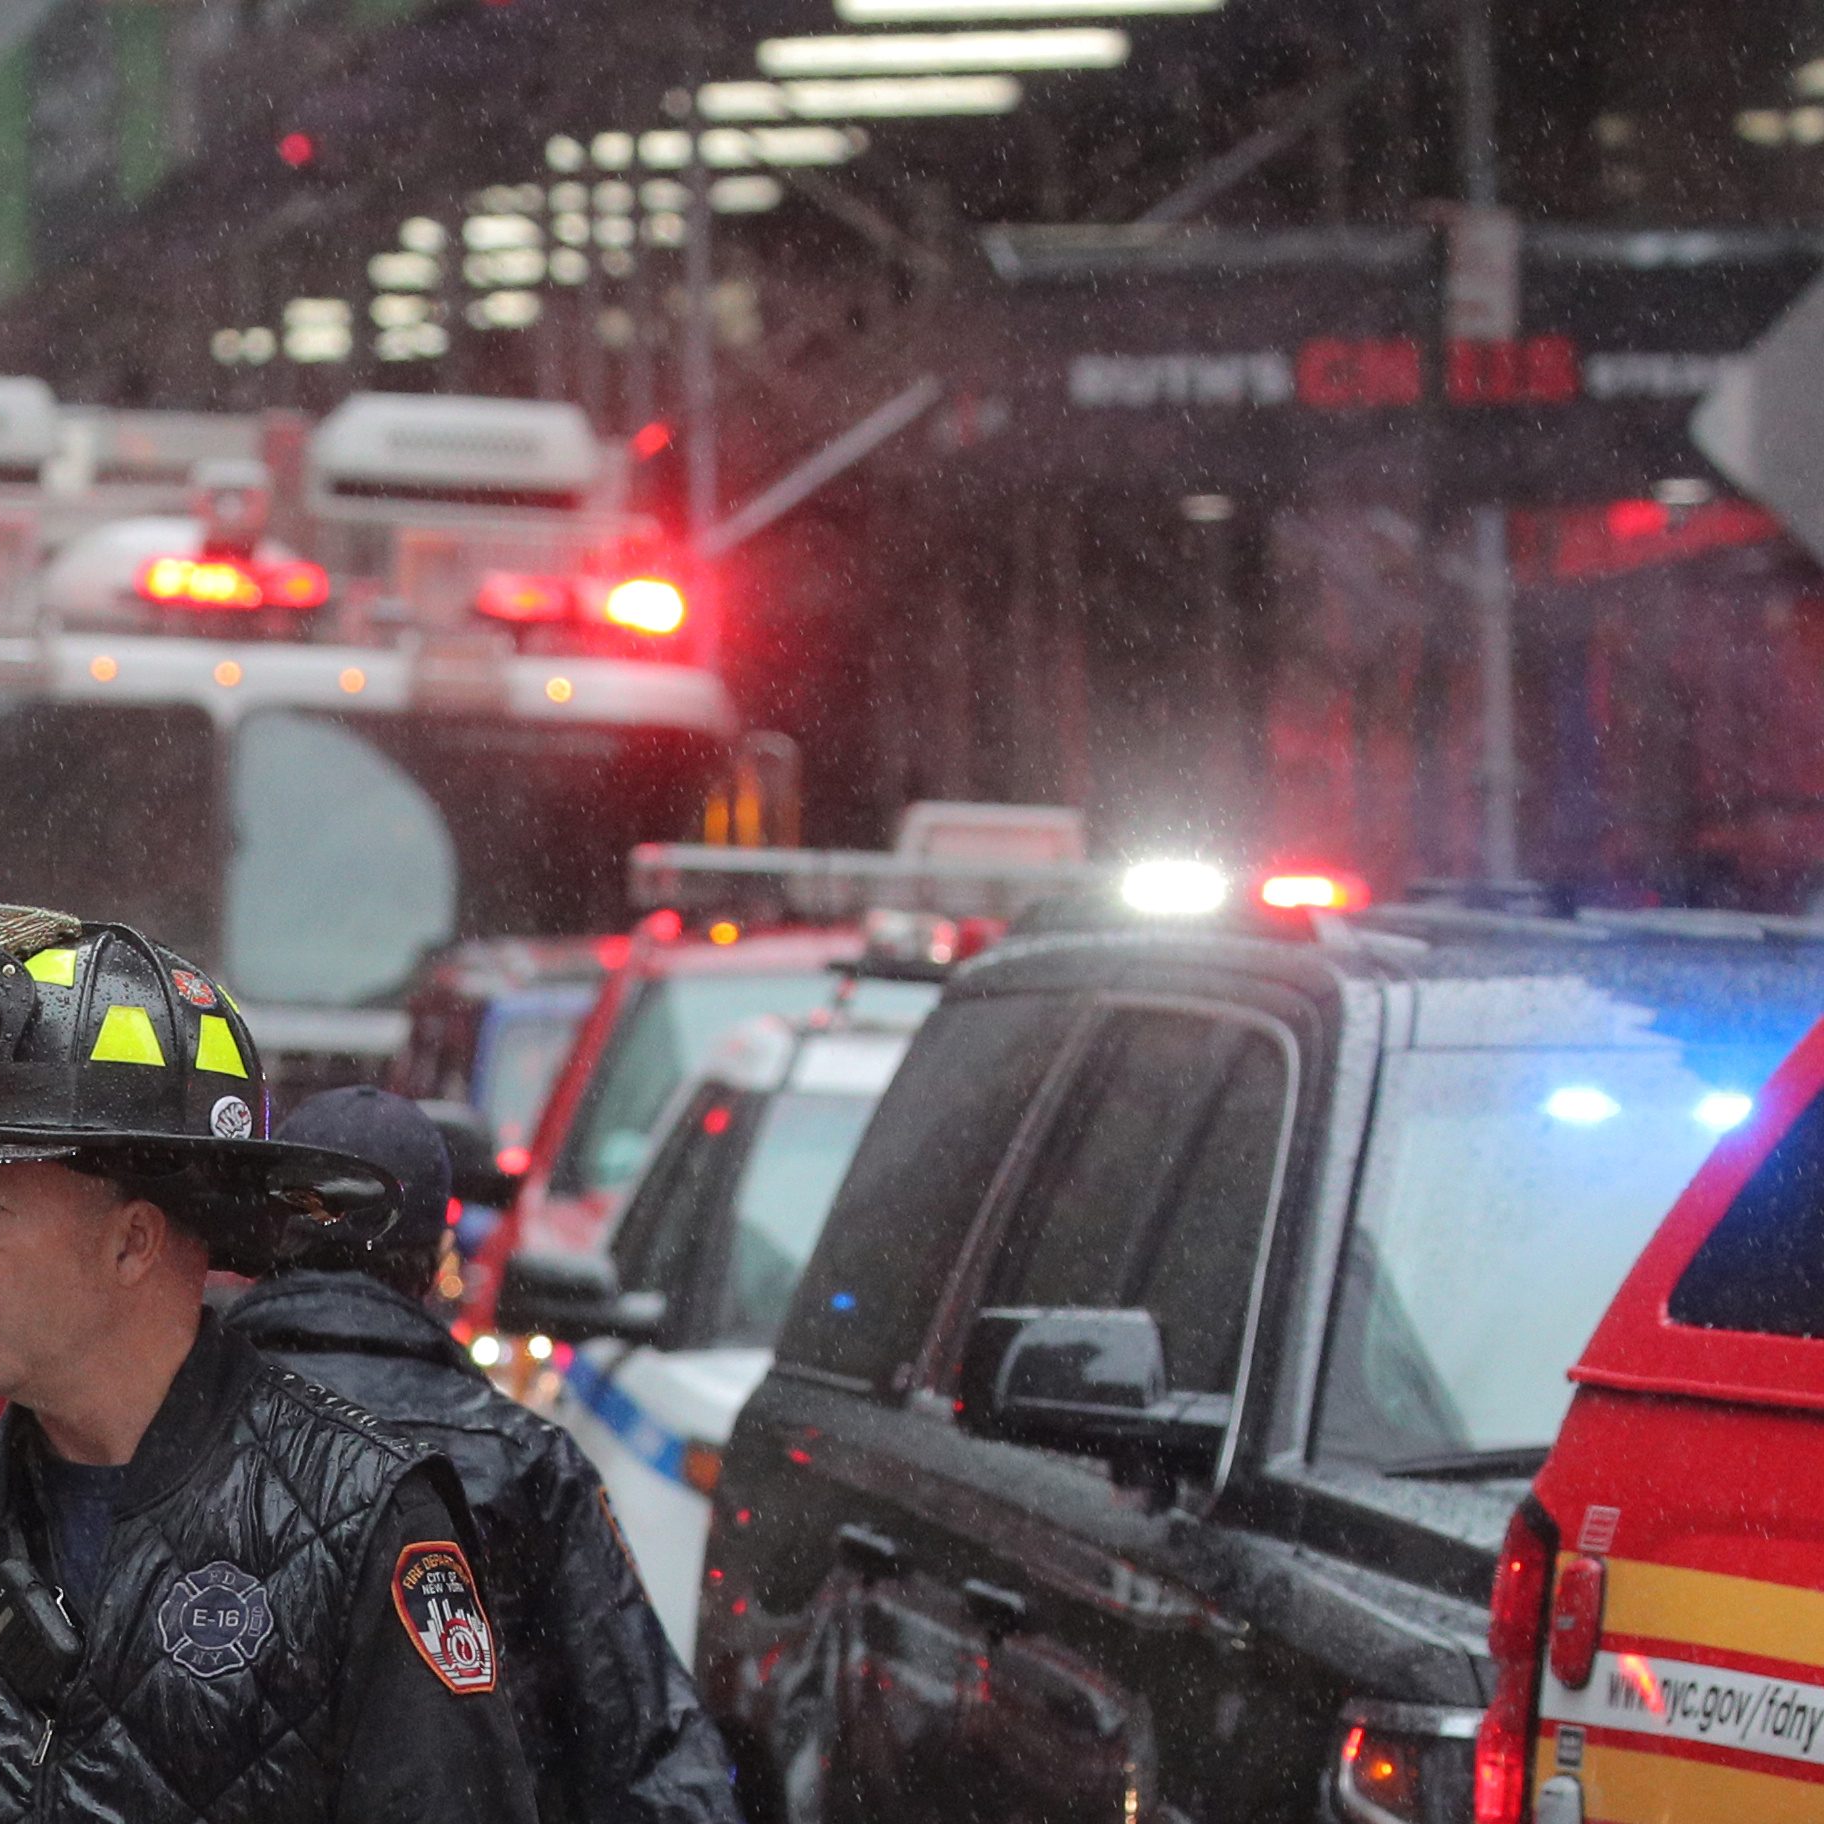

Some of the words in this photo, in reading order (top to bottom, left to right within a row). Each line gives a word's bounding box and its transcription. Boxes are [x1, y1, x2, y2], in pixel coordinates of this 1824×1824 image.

[403, 1562, 426, 1590] FIRE
[427, 1572, 446, 1582] CITY
[448, 1572, 457, 1582] OF
[422, 1584, 444, 1595] NEW
[193, 1609, 240, 1627] E-16
[1608, 1669, 1824, 1753] wwnyc.gov/fdny
